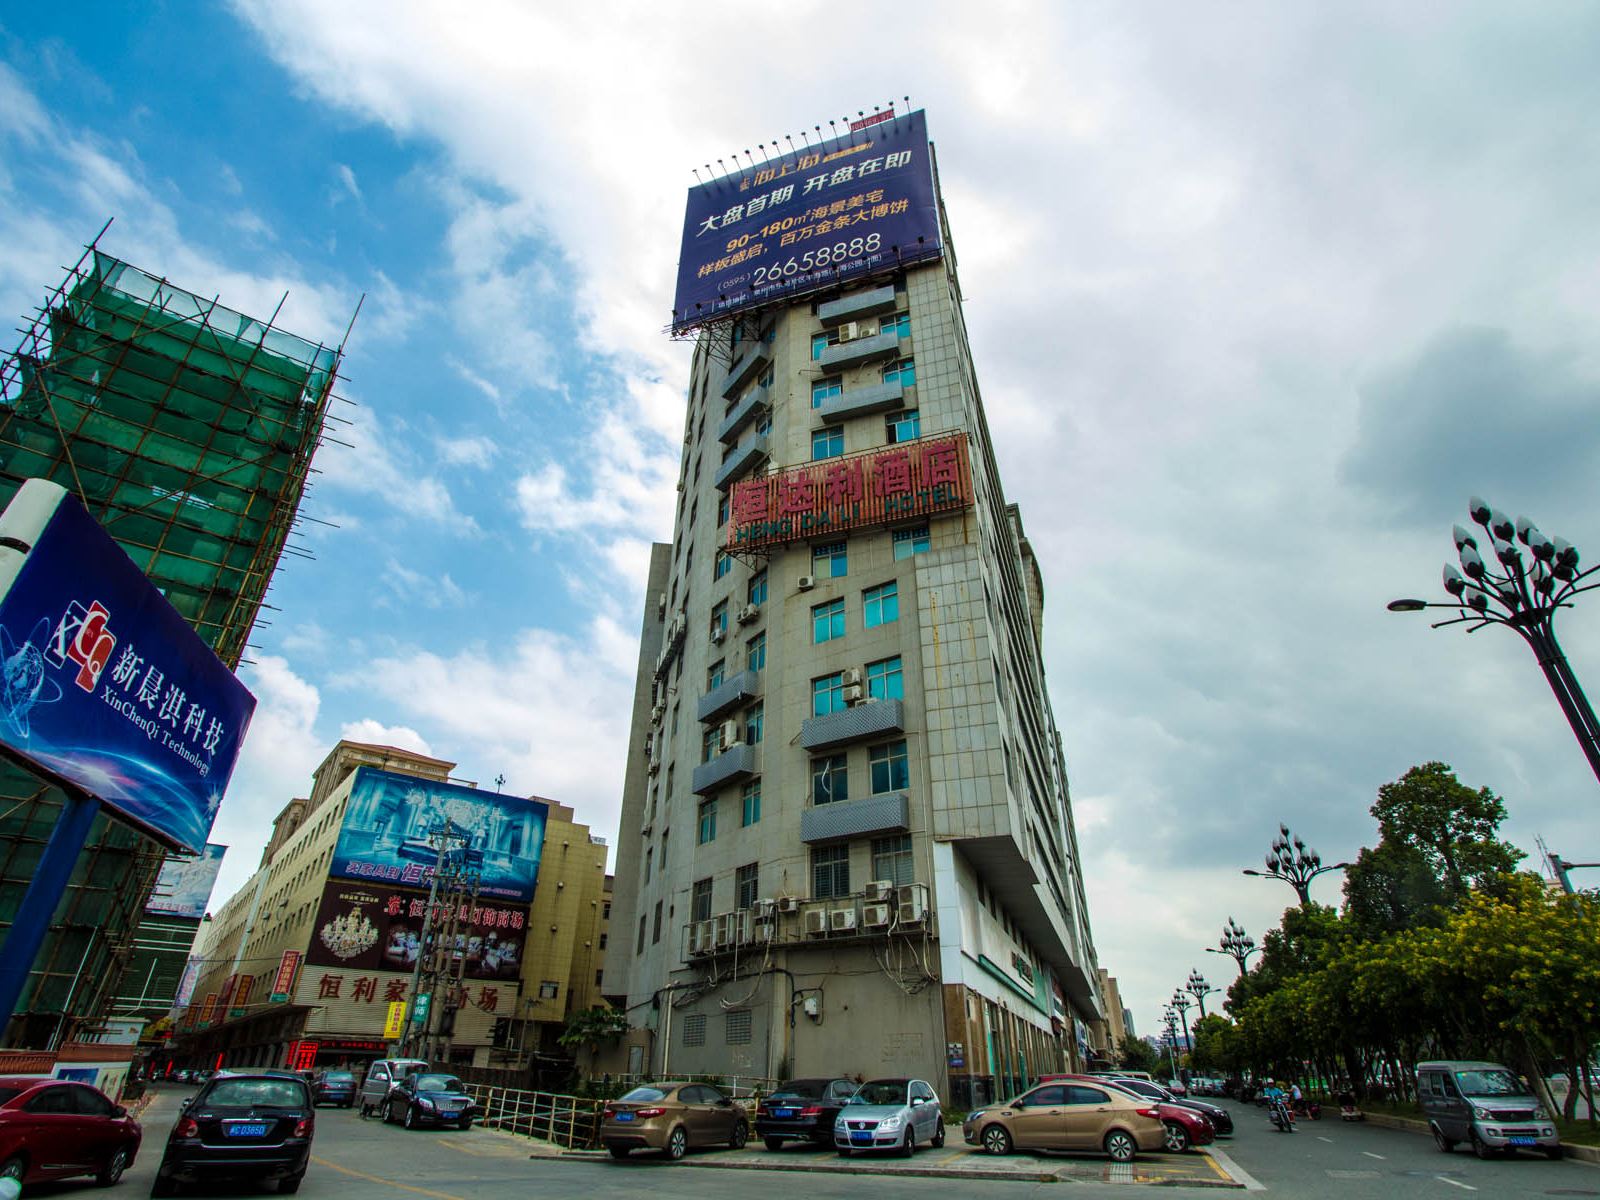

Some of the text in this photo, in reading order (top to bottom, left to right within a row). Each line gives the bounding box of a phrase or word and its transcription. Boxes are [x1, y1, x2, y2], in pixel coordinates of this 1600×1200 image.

[696, 150, 912, 237] 大盘首期 开盘在即
[753, 233, 881, 286] 26658888
[734, 437, 957, 525] 恒达利酒店
[736, 486, 959, 543] HENG DA LI HOTEL
[100, 685, 210, 777] XinChenQi Technology
[111, 643, 224, 756] 新晨淇科技
